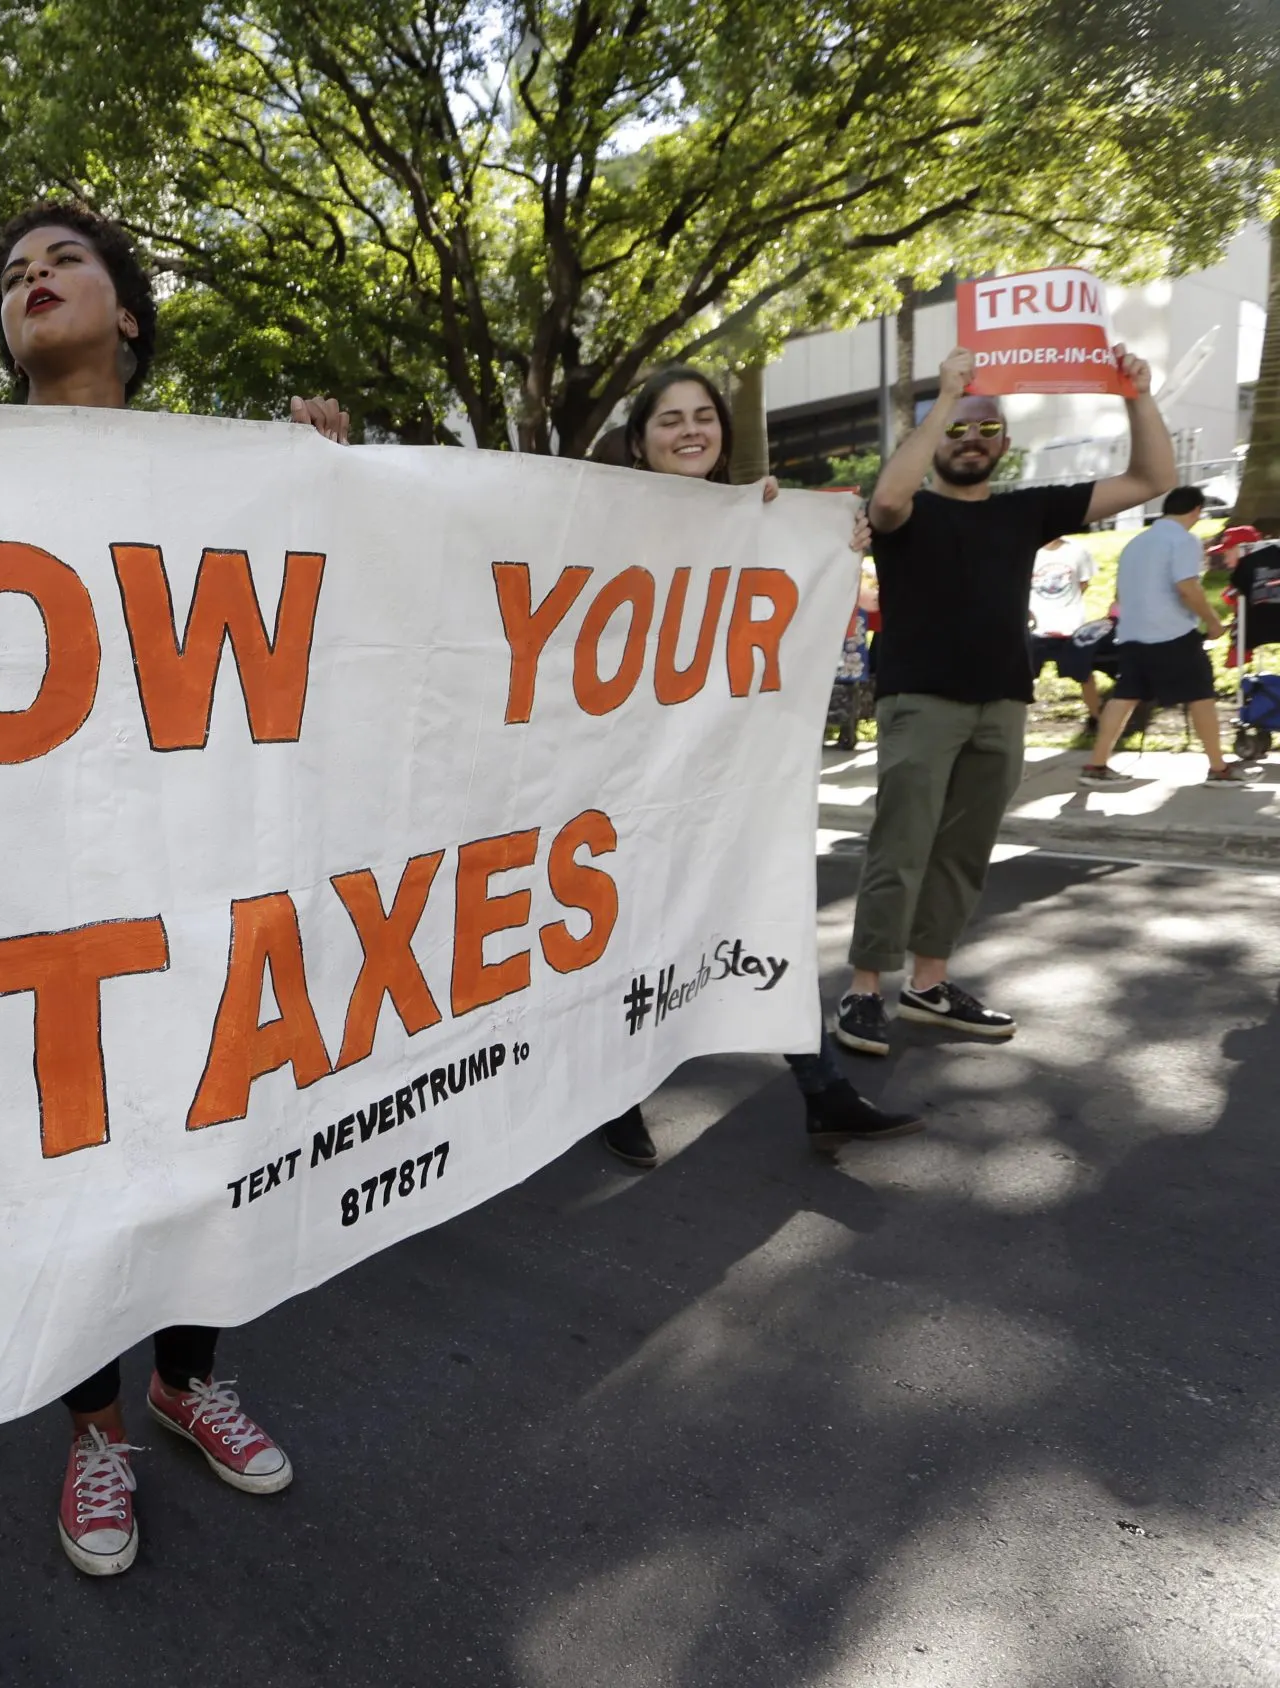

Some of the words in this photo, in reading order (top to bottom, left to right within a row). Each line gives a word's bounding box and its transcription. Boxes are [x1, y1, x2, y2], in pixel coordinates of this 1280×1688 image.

[974, 347, 1118, 368] DIVIDER-IN-CH
[491, 561, 800, 725] YOUR
[227, 1149, 303, 1209] TEXT
[310, 1041, 506, 1169] NEVERTRUMP
[512, 1041, 531, 1066] to
[340, 1142, 450, 1227] 877877
